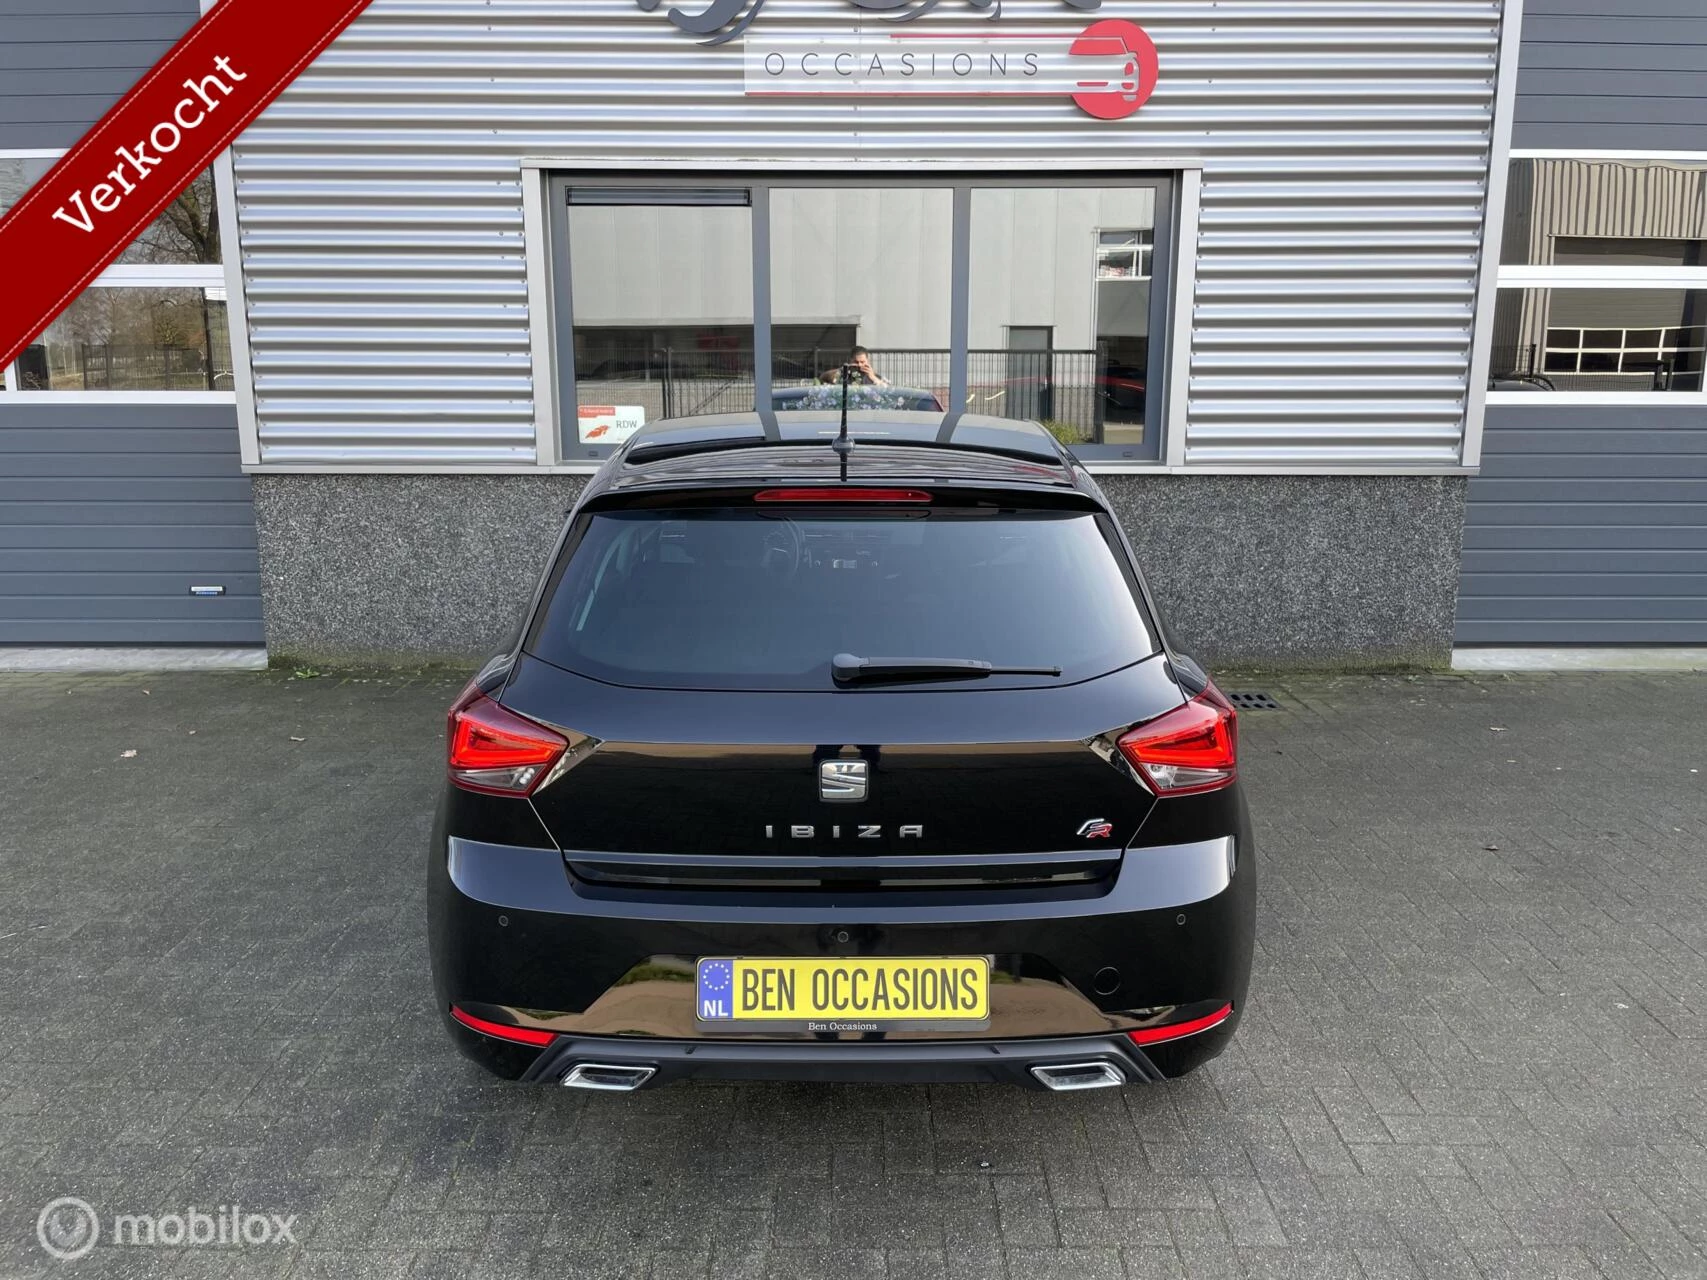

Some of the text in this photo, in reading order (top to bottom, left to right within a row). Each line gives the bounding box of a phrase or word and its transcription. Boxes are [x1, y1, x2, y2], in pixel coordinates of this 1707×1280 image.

[764, 52, 1040, 77] OCCASIONS
[616, 420, 638, 429] RDW
[765, 824, 924, 839] IBIZA
[1076, 818, 1113, 838] FR
[741, 967, 979, 1012] BEN OCCASIONS
[703, 999, 729, 1018] NL
[807, 1020, 878, 1031] Ben Occasions
